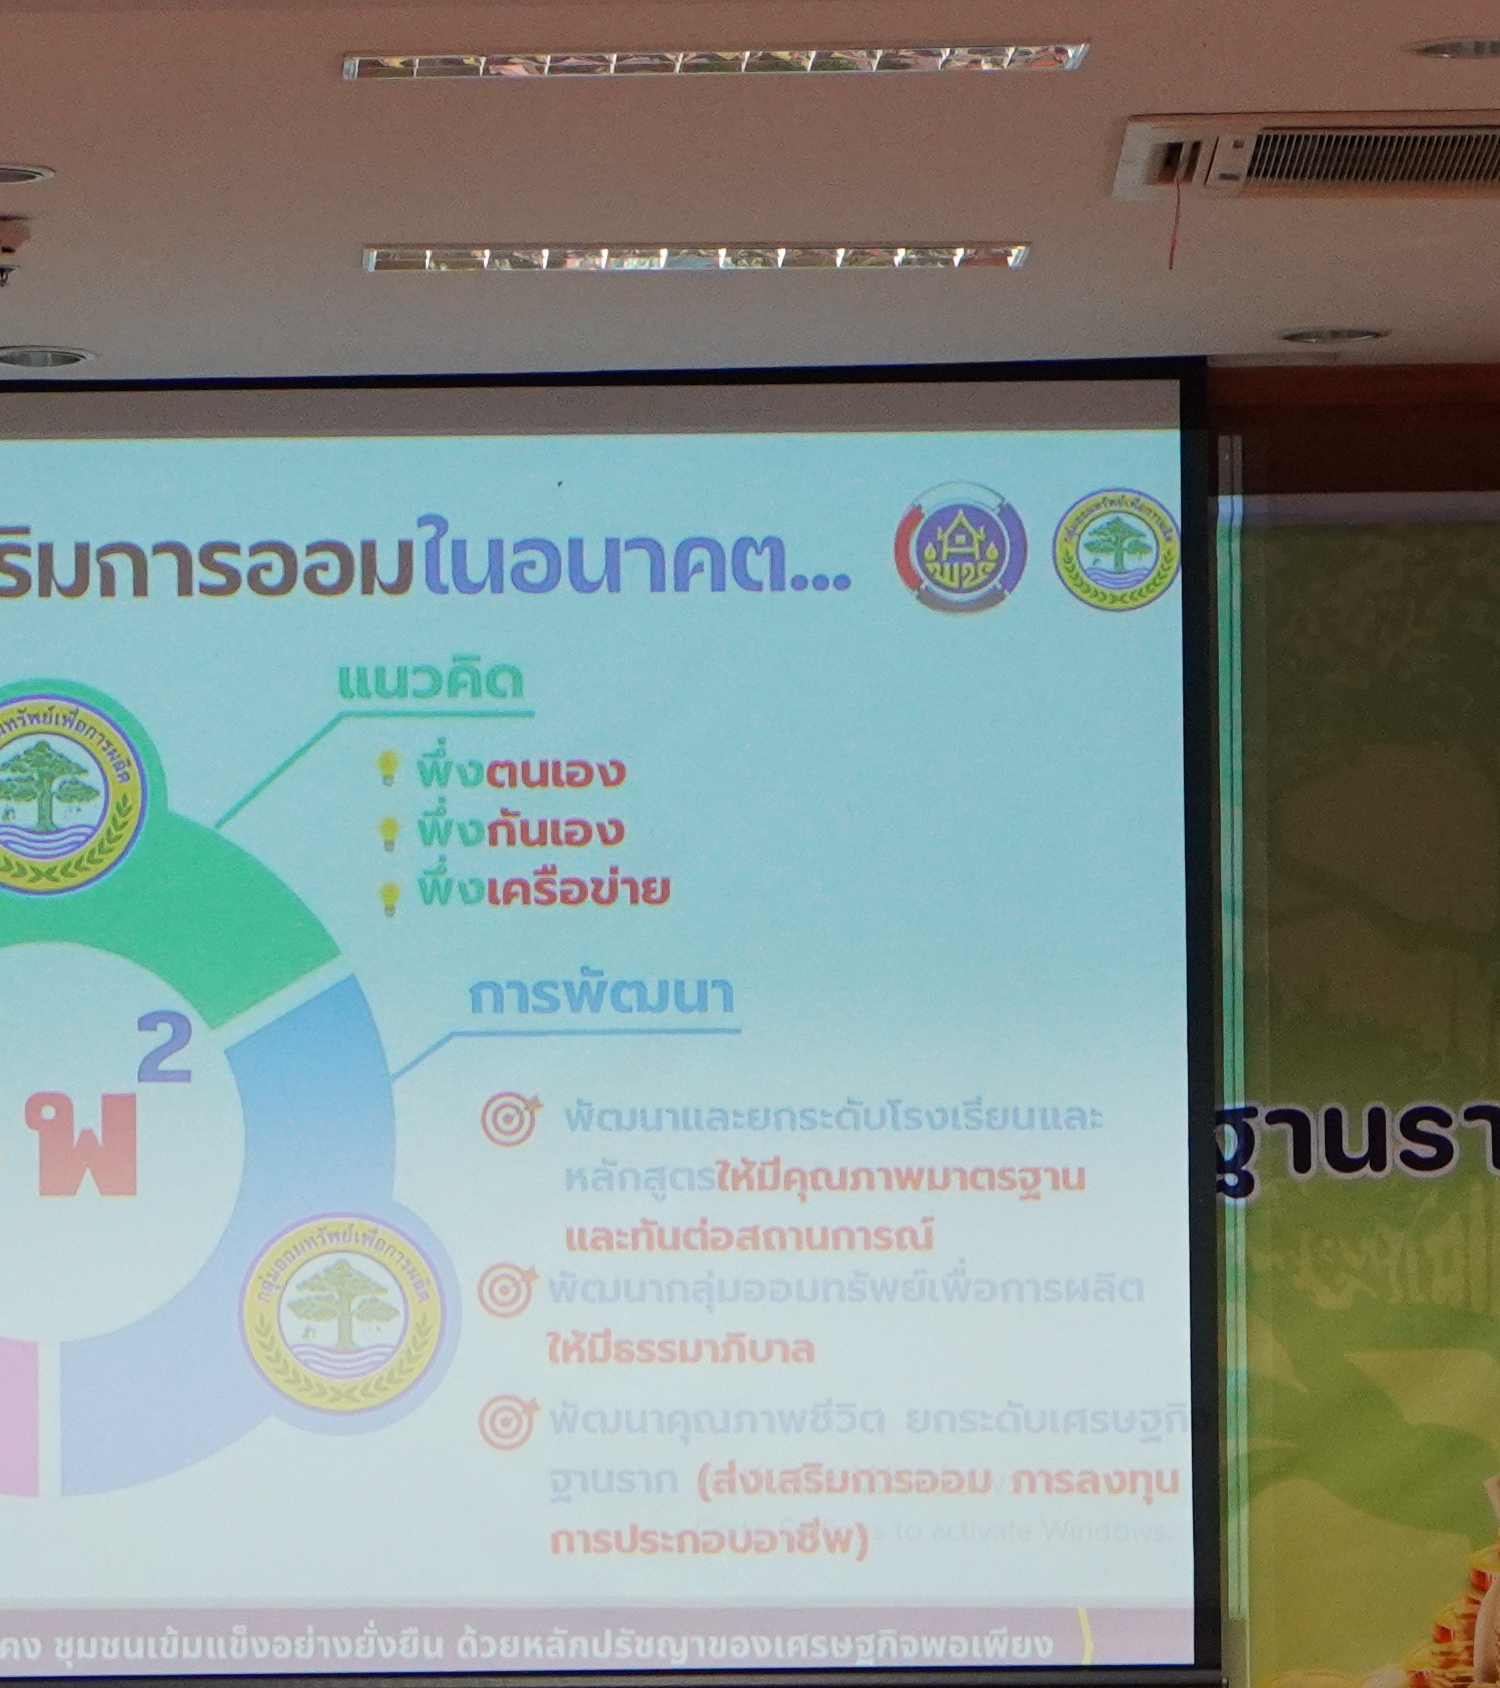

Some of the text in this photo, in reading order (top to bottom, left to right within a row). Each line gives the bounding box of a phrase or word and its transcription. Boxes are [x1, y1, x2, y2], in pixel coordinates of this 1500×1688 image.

[338, 655, 524, 700] แนวคิด
[416, 737, 627, 791] พึ่งตนเอง
[416, 797, 626, 850] พึ่งกันเอง
[416, 857, 672, 908] พึ่งเครือข่าย
[468, 964, 734, 1014] การพัฒนา
[565, 1096, 1103, 1133] พัฒนาและยกระดับโรงเรียนและ
[565, 1155, 1087, 1204] หลักสูตรให้มีคุณภาพมาตรฐาน
[566, 1216, 935, 1252] และทันต่อสถานการณ์
[548, 1258, 1145, 1313] พัฒนากลุ่มออมทรัพย์เพื่อการผลิต
[547, 1329, 815, 1364] ให้มีธรรมาภิบาล
[549, 1403, 885, 1446] พัฒนาคุณภาพชีวิต
[549, 1460, 1180, 1507] ฐานราก (ส่งเสริมการออม การลงทุน
[551, 1518, 869, 1562] การประกอบอาชีพ)
[55, 1620, 443, 1668] ชุมชนเข้มแข็งอย่างยั่งยืน
[457, 1625, 1055, 1666] ด้วยหลักปรัชญาของเศรษฐกิจพอเพียง
